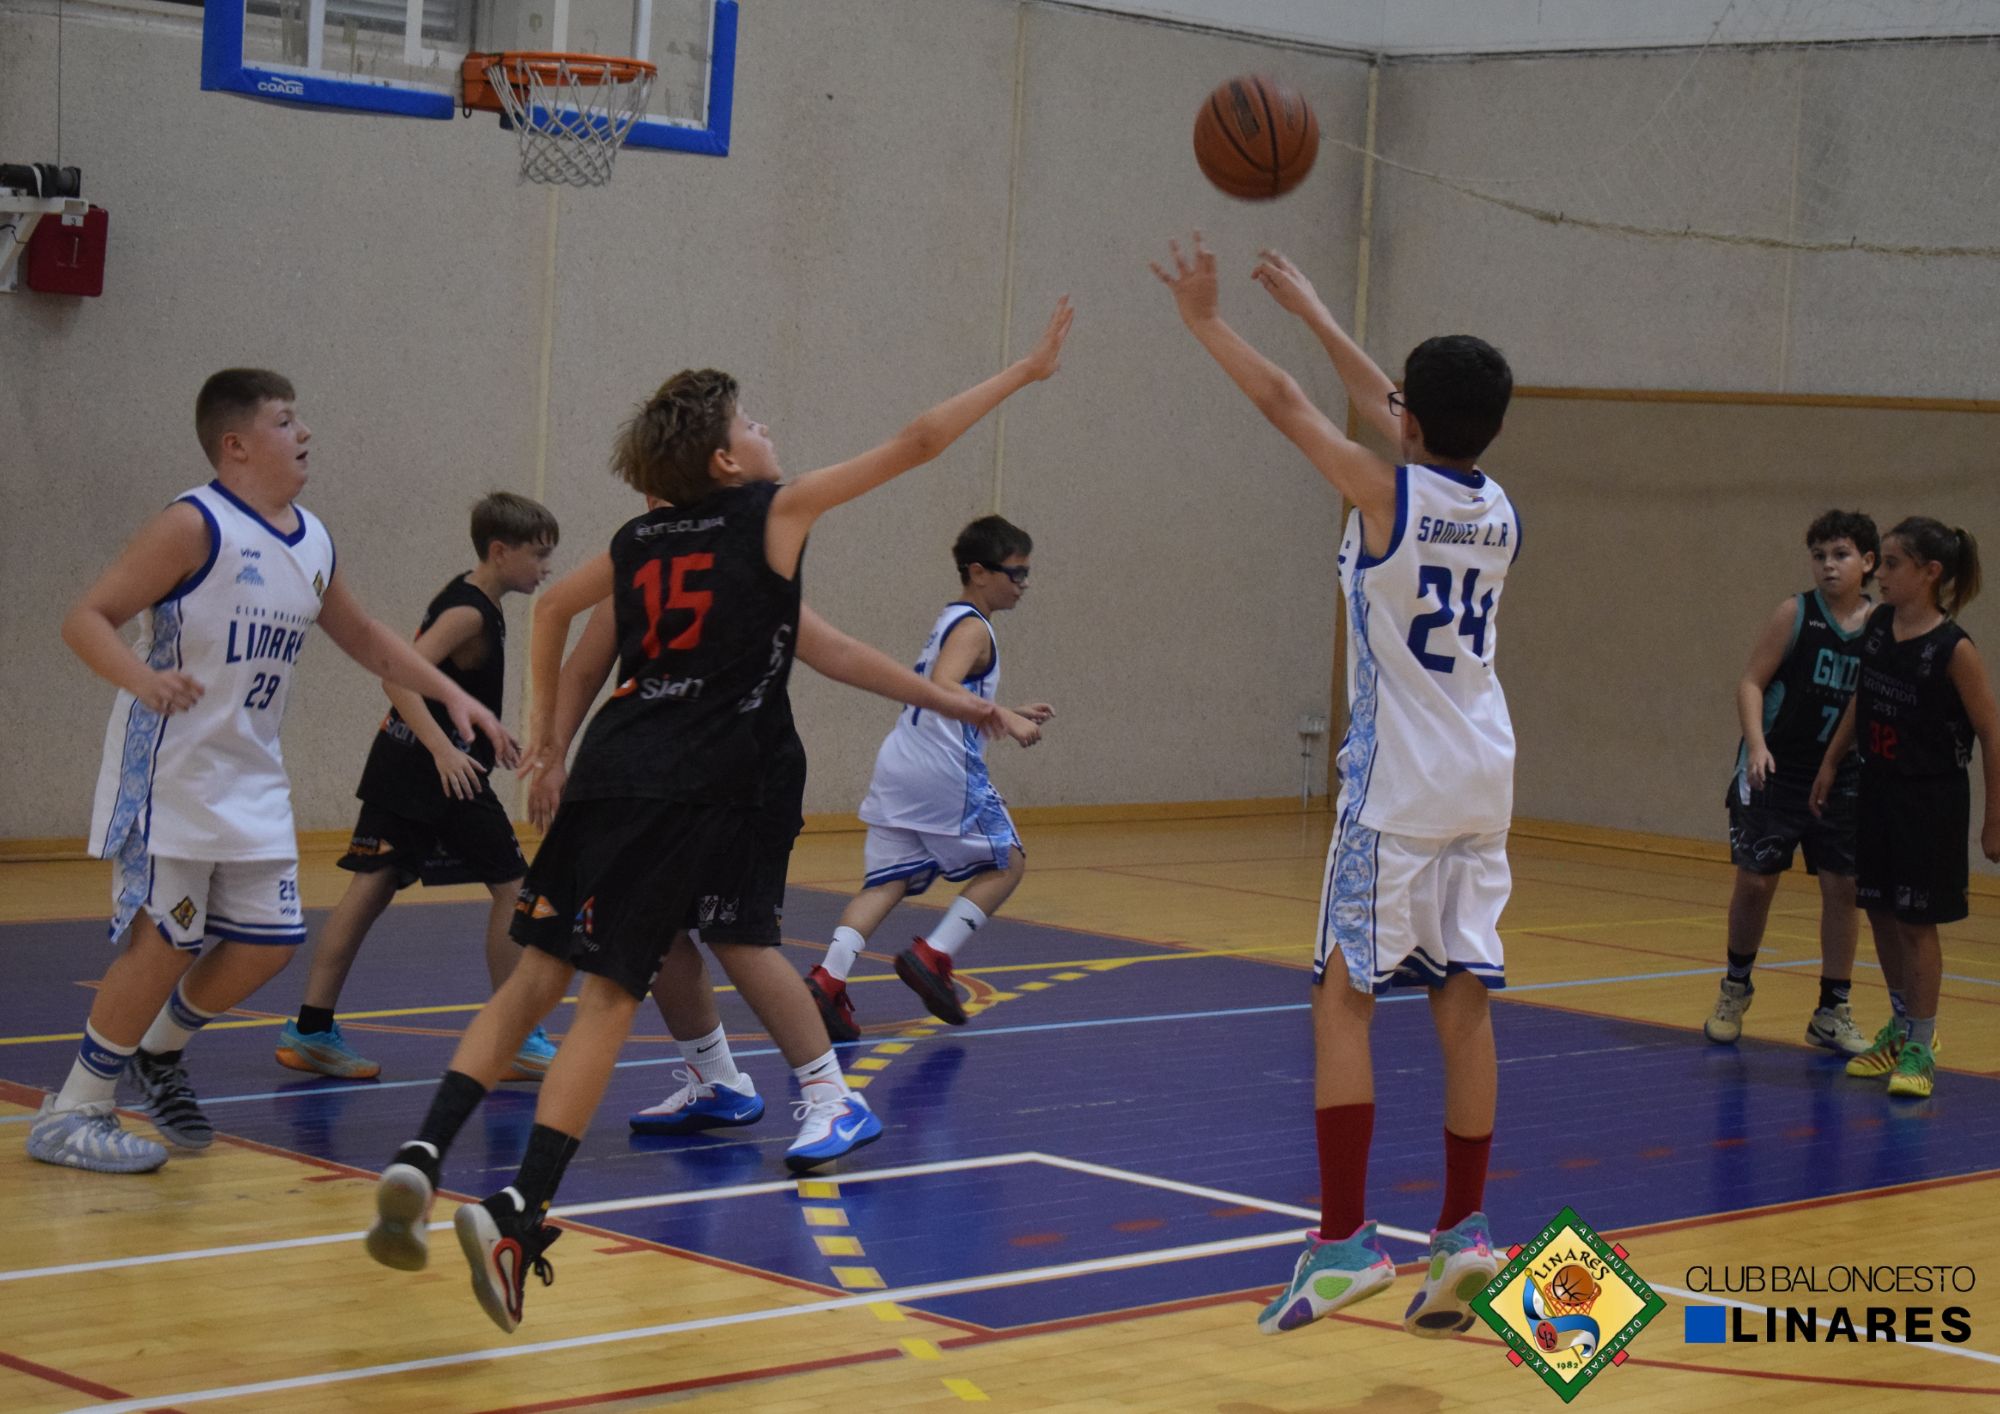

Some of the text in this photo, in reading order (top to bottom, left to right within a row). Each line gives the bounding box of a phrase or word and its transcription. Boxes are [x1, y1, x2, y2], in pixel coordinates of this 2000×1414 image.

[257, 80, 304, 95] COADE
[1417, 515, 1479, 545] SAMUEL
[632, 553, 715, 659] 15
[1407, 564, 1494, 674] 24
[244, 671, 281, 710] 29
[1816, 704, 1840, 743] 7
